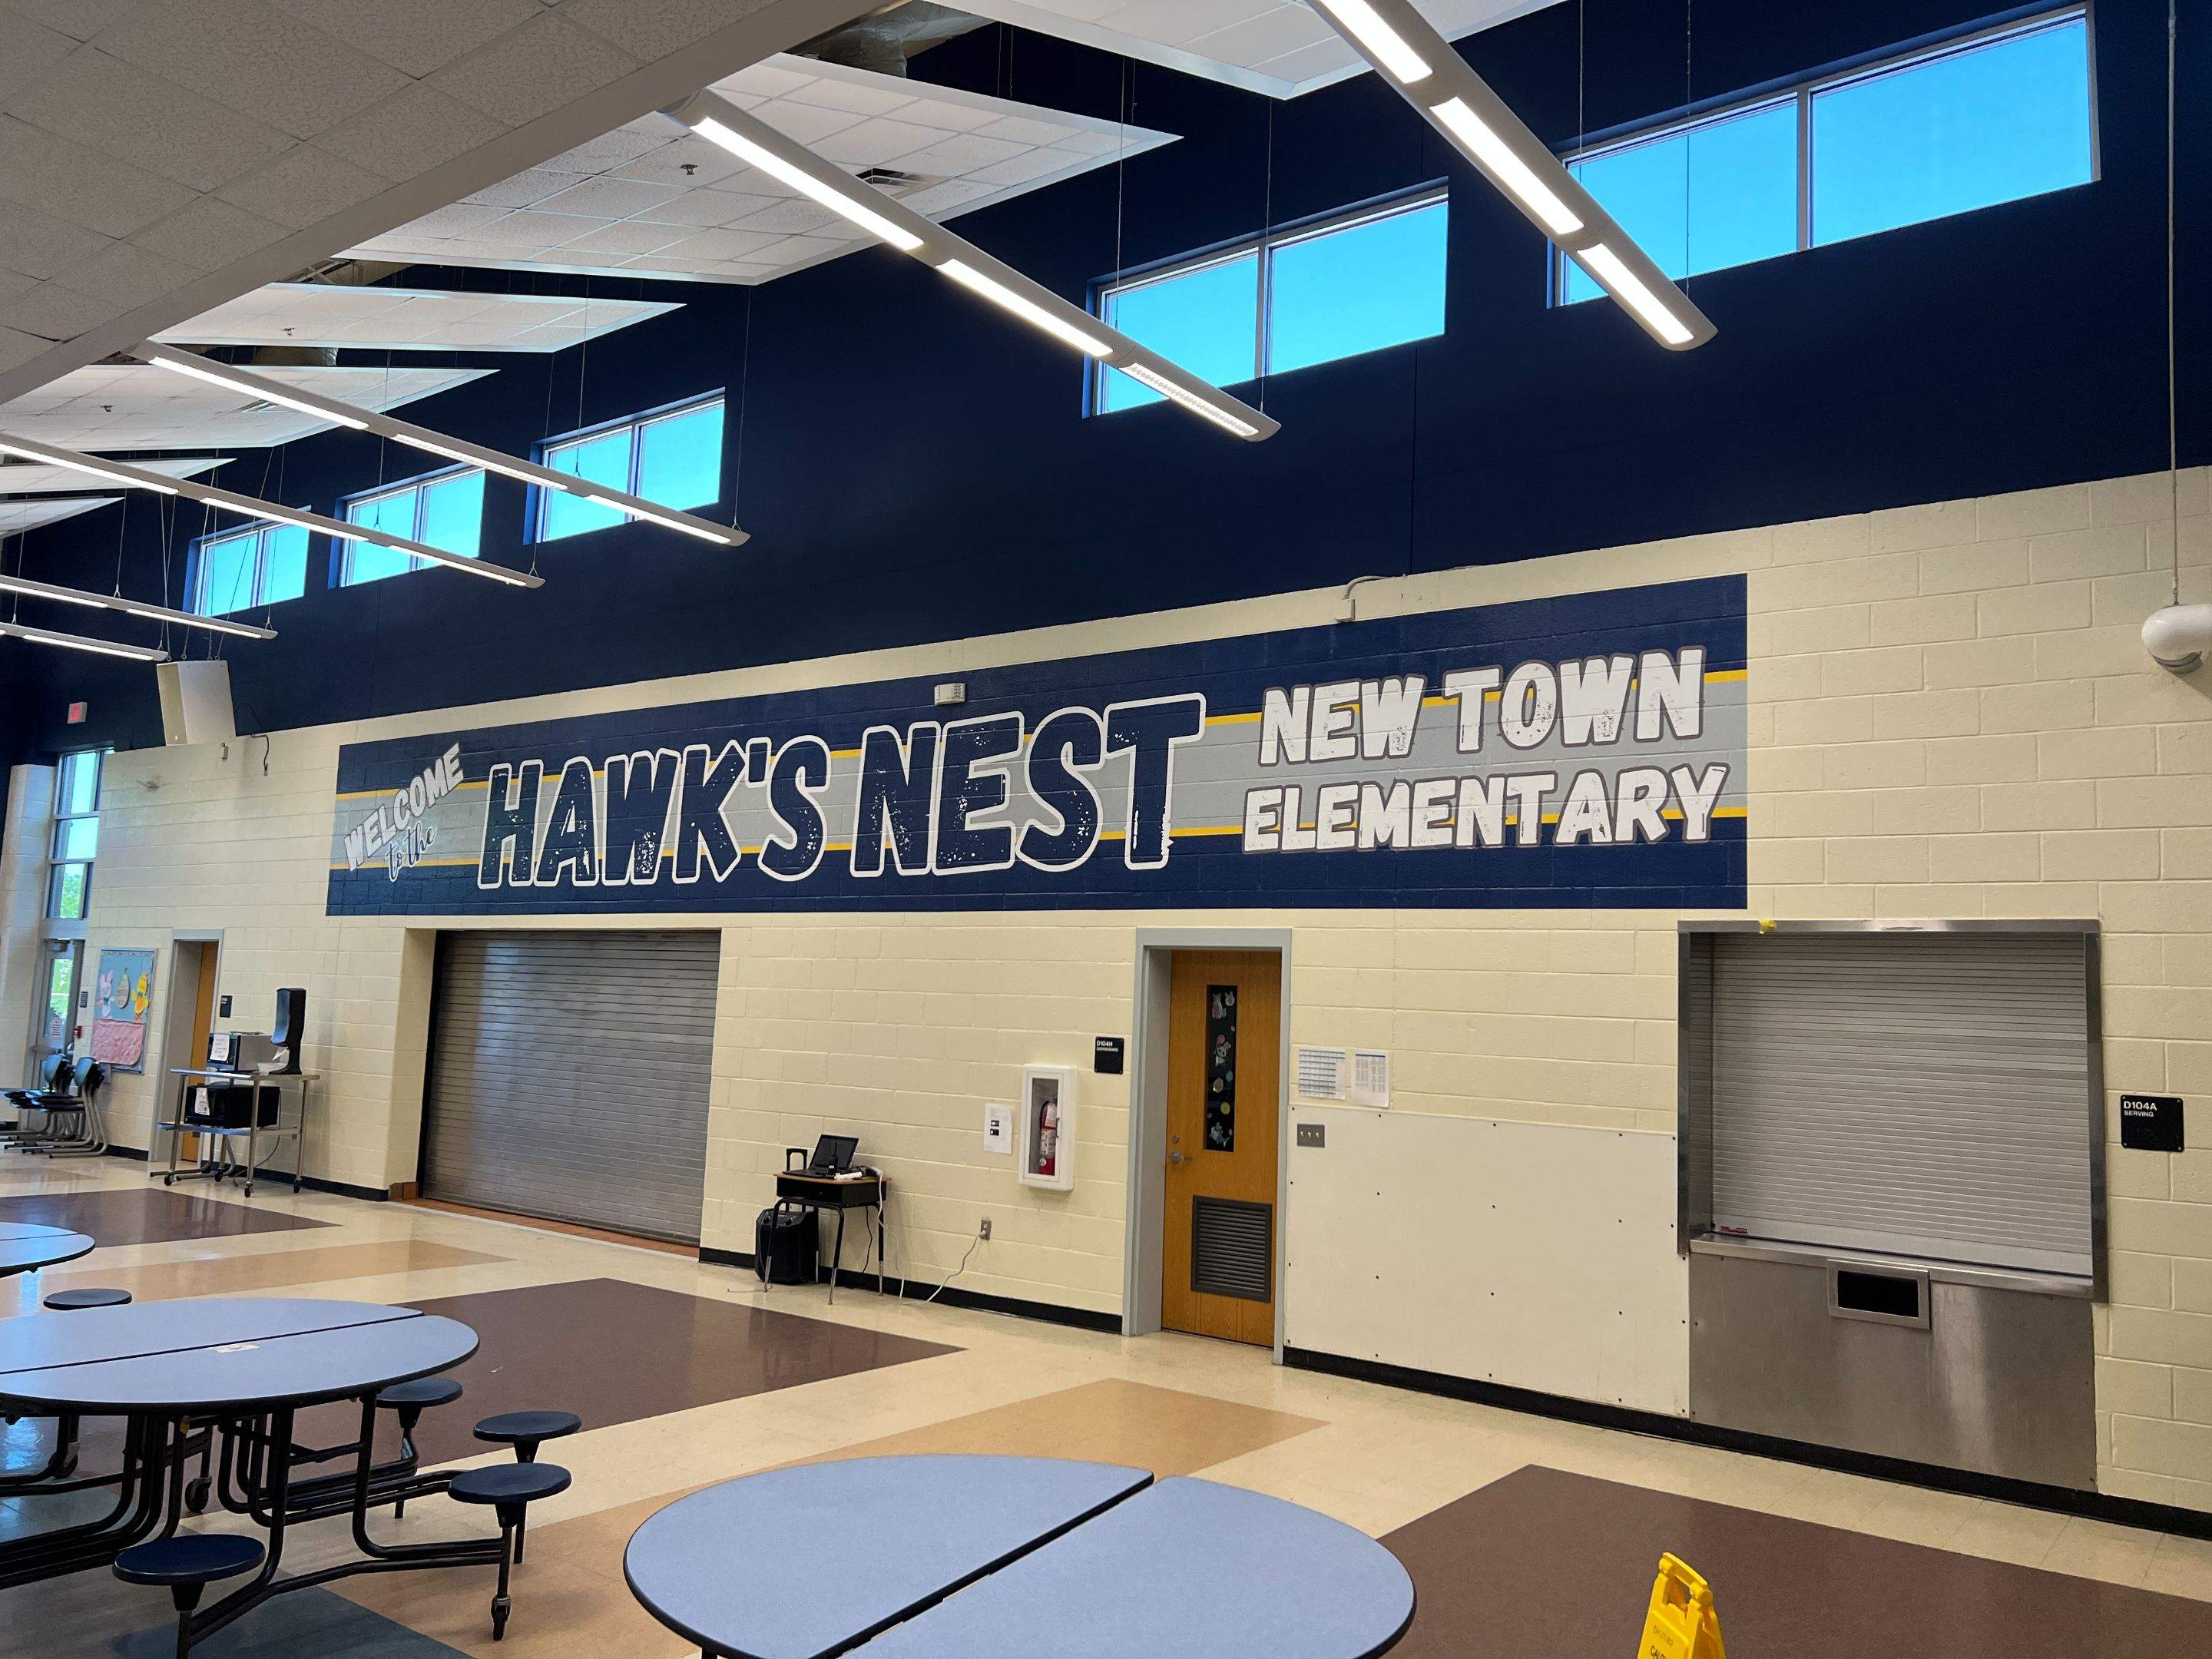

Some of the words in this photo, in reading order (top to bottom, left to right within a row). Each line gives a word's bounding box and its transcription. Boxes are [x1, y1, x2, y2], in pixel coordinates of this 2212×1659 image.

[1260, 674, 1427, 765] NEW
[1442, 645, 1706, 753] TOWN
[343, 742, 464, 872] WELCOME
[477, 735, 832, 889] HAWK'S
[849, 692, 1207, 877] NEST
[1243, 763, 1730, 853] ELEMENTARY
[385, 841, 405, 882] to
[402, 820, 437, 866] the
[2123, 1101, 2157, 1111] D104A
